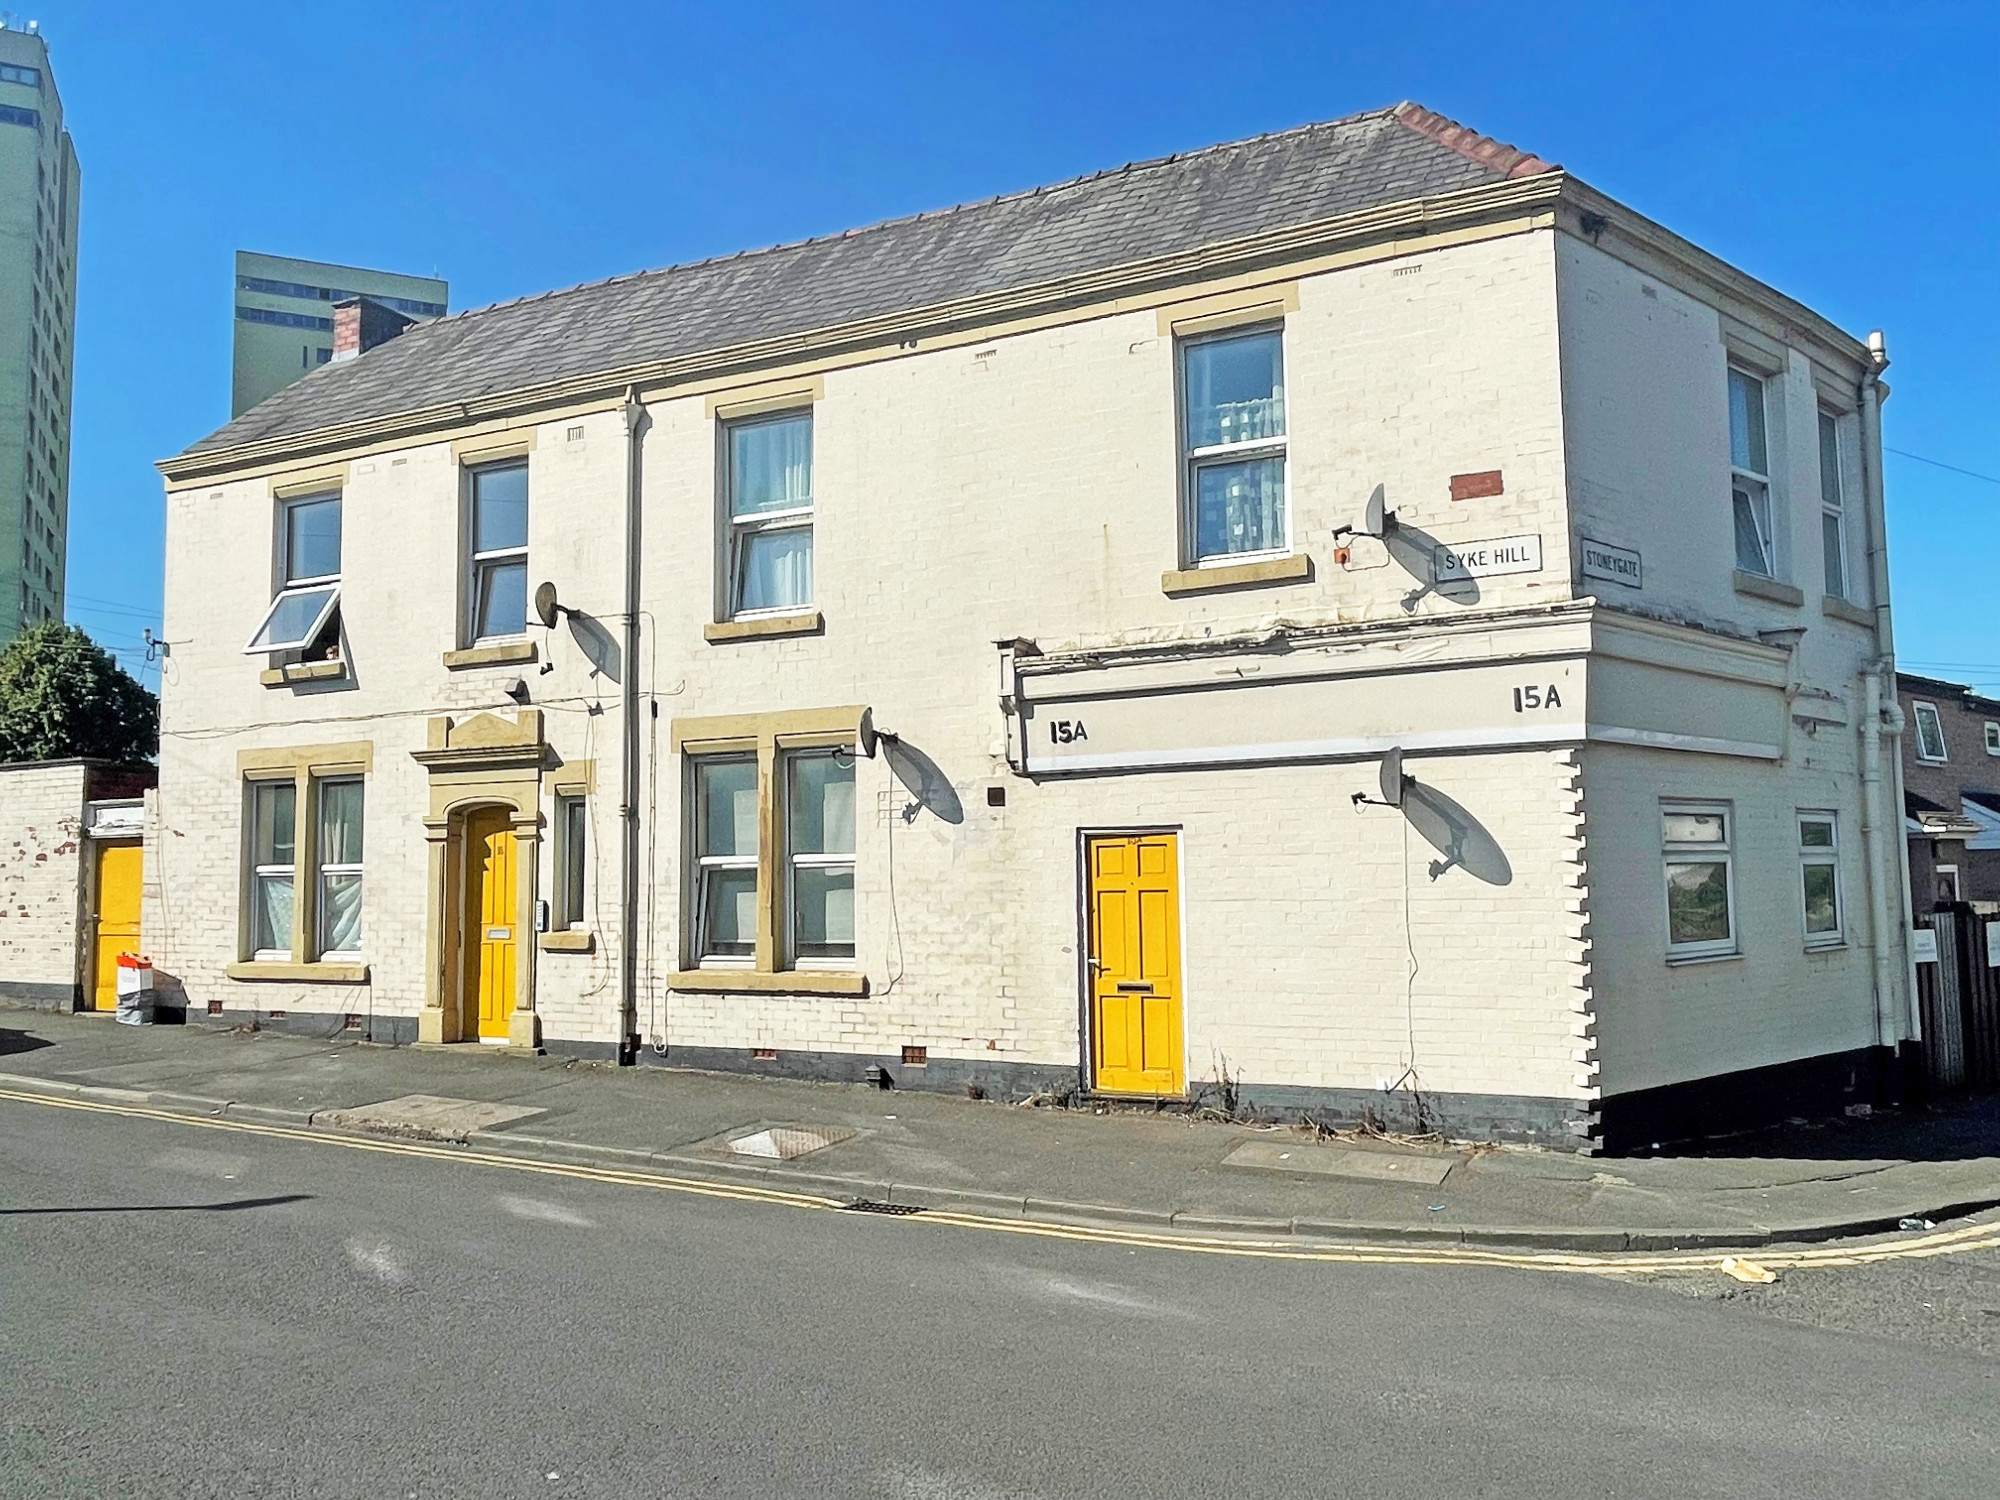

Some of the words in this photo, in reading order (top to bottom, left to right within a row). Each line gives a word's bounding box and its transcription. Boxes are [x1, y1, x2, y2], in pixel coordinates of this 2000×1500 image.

[1445, 551, 1488, 570] SYKE
[1494, 546, 1531, 564] HILL
[1586, 550, 1638, 577] STONEYGATE
[1513, 684, 1562, 713] 15A
[1050, 720, 1088, 744] 15A
